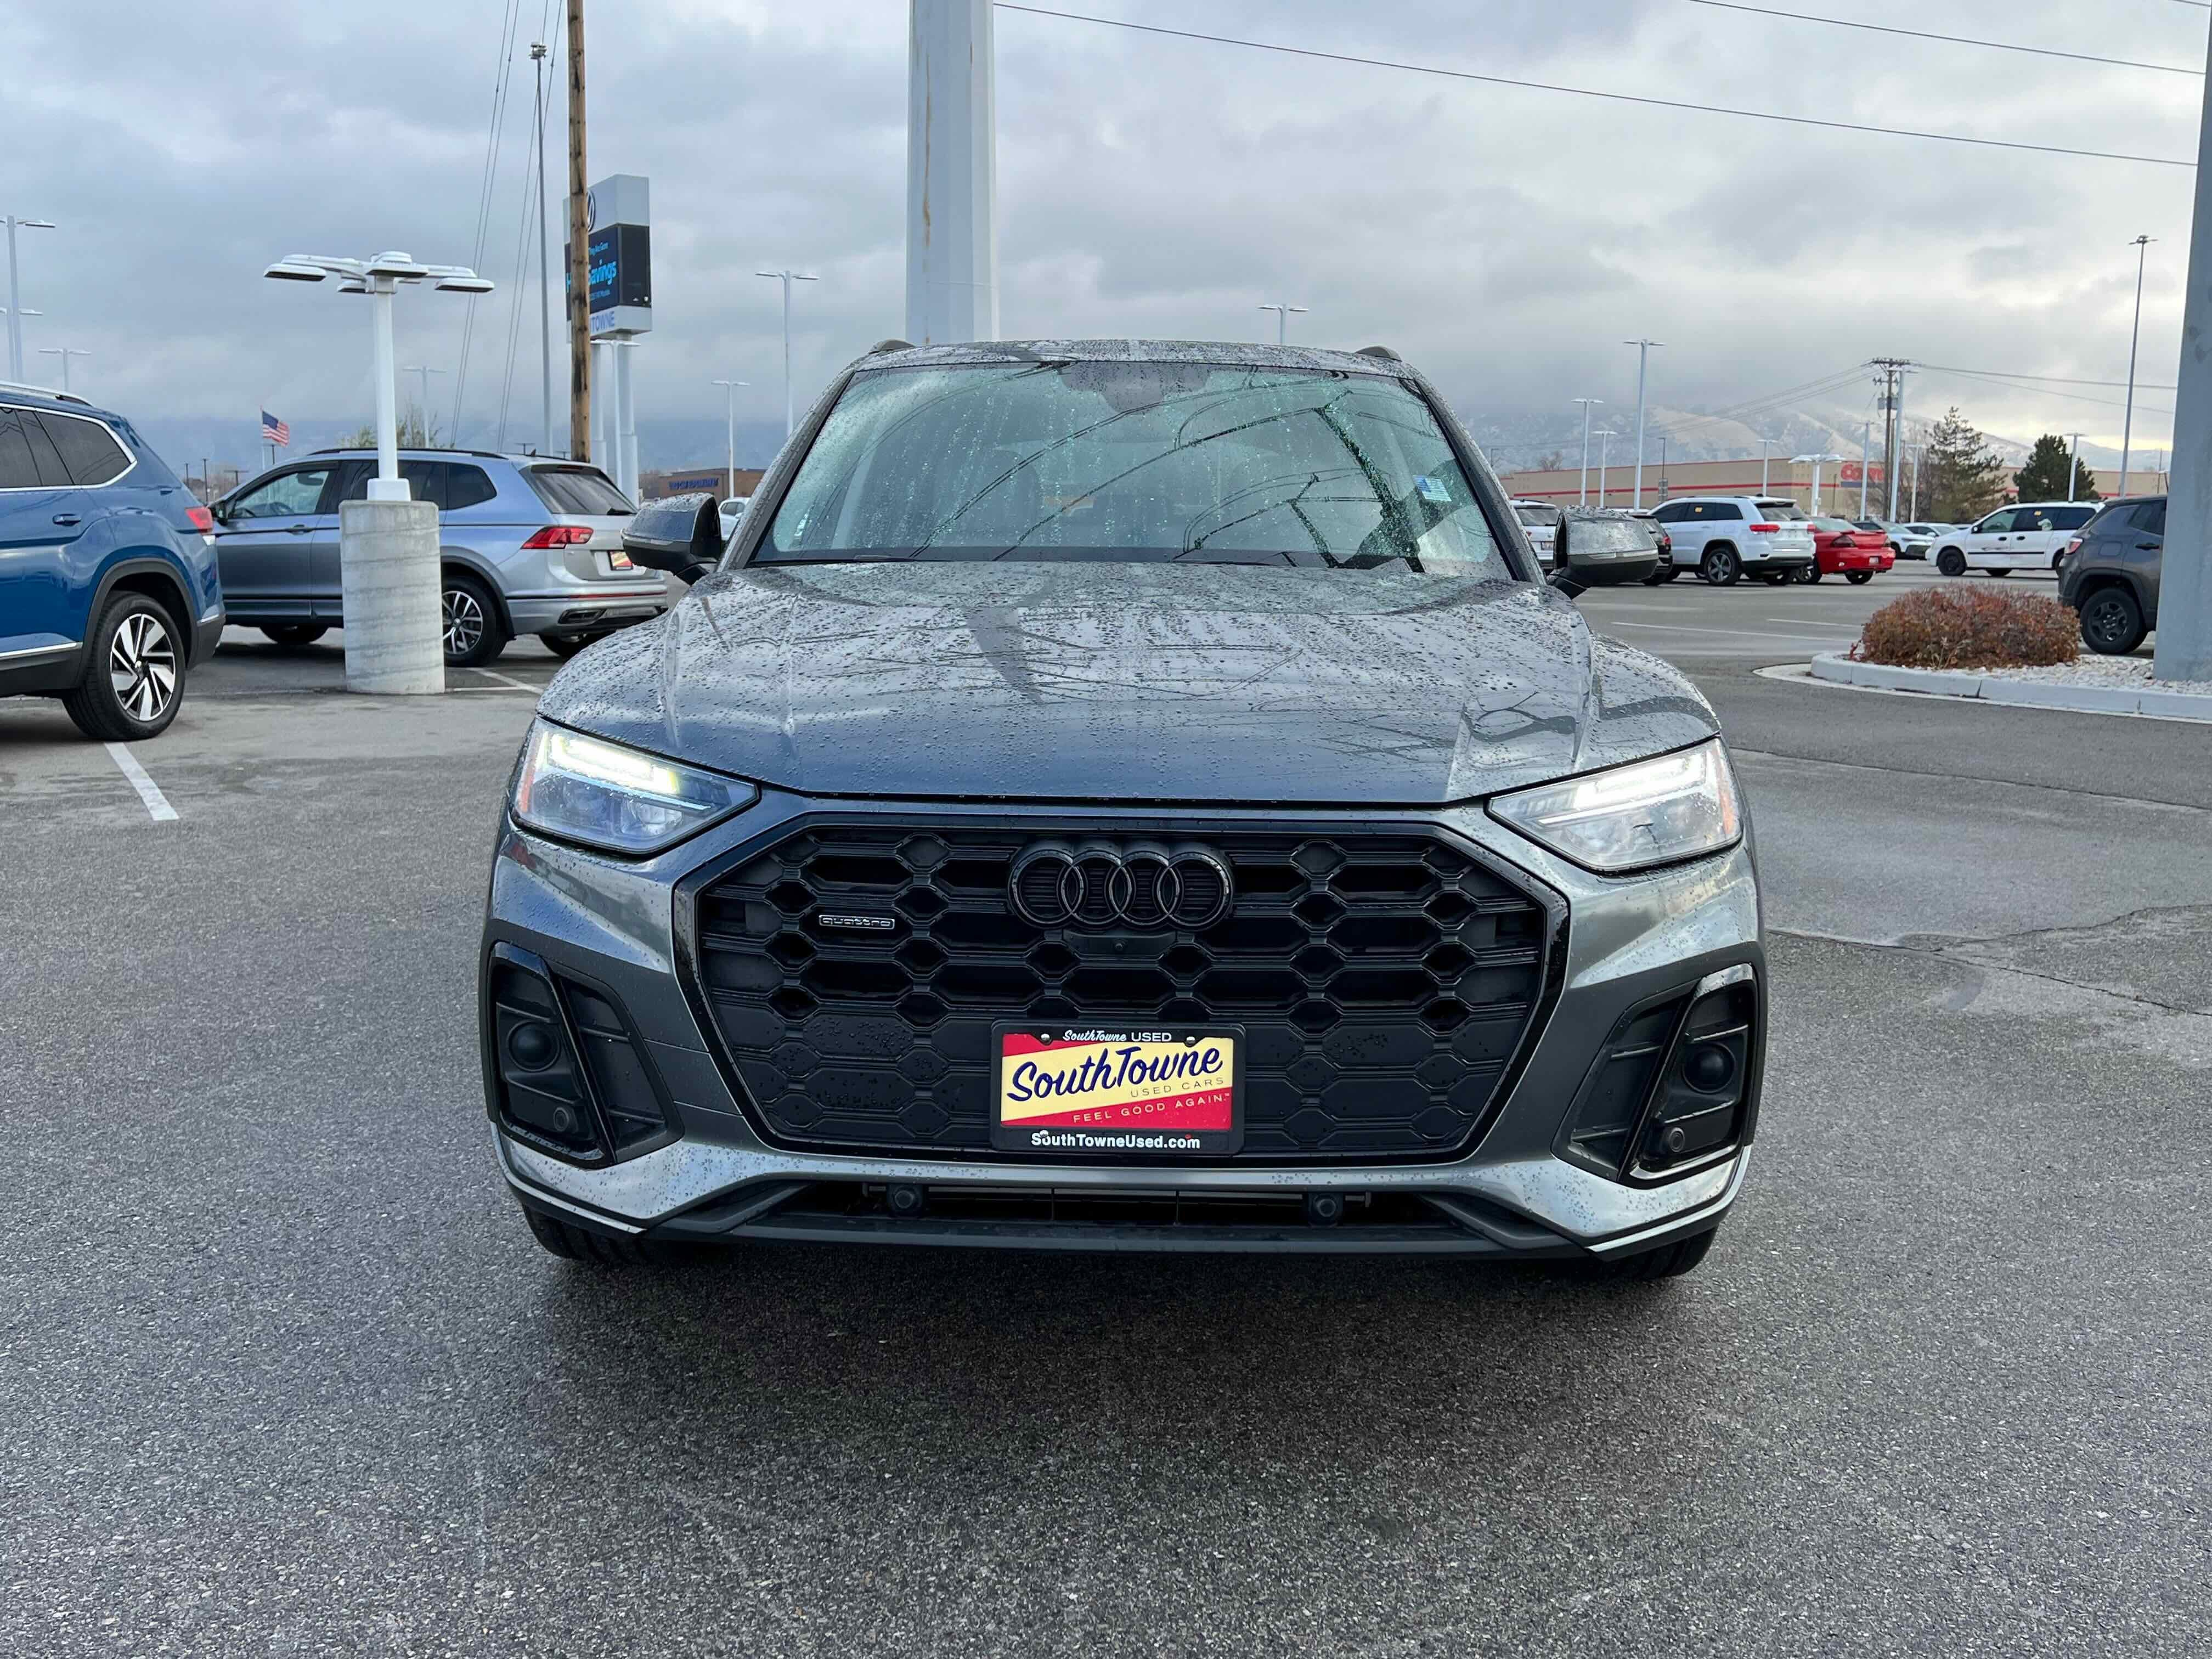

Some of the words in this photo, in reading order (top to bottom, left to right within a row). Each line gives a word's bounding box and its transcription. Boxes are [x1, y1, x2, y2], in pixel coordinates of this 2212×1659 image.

[822, 918, 891, 926] quattro
[1063, 1030, 1126, 1042] SouthTowne
[1131, 1032, 1172, 1041] USED
[1007, 1046, 1223, 1101] SouthTowne
[1130, 1085, 1172, 1098] USED
[1181, 1077, 1224, 1090] CARS
[1073, 1111, 1112, 1124] FEEL
[1121, 1102, 1165, 1117] GOOD
[1031, 1131, 1200, 1149] SouthTowneUsed.com
